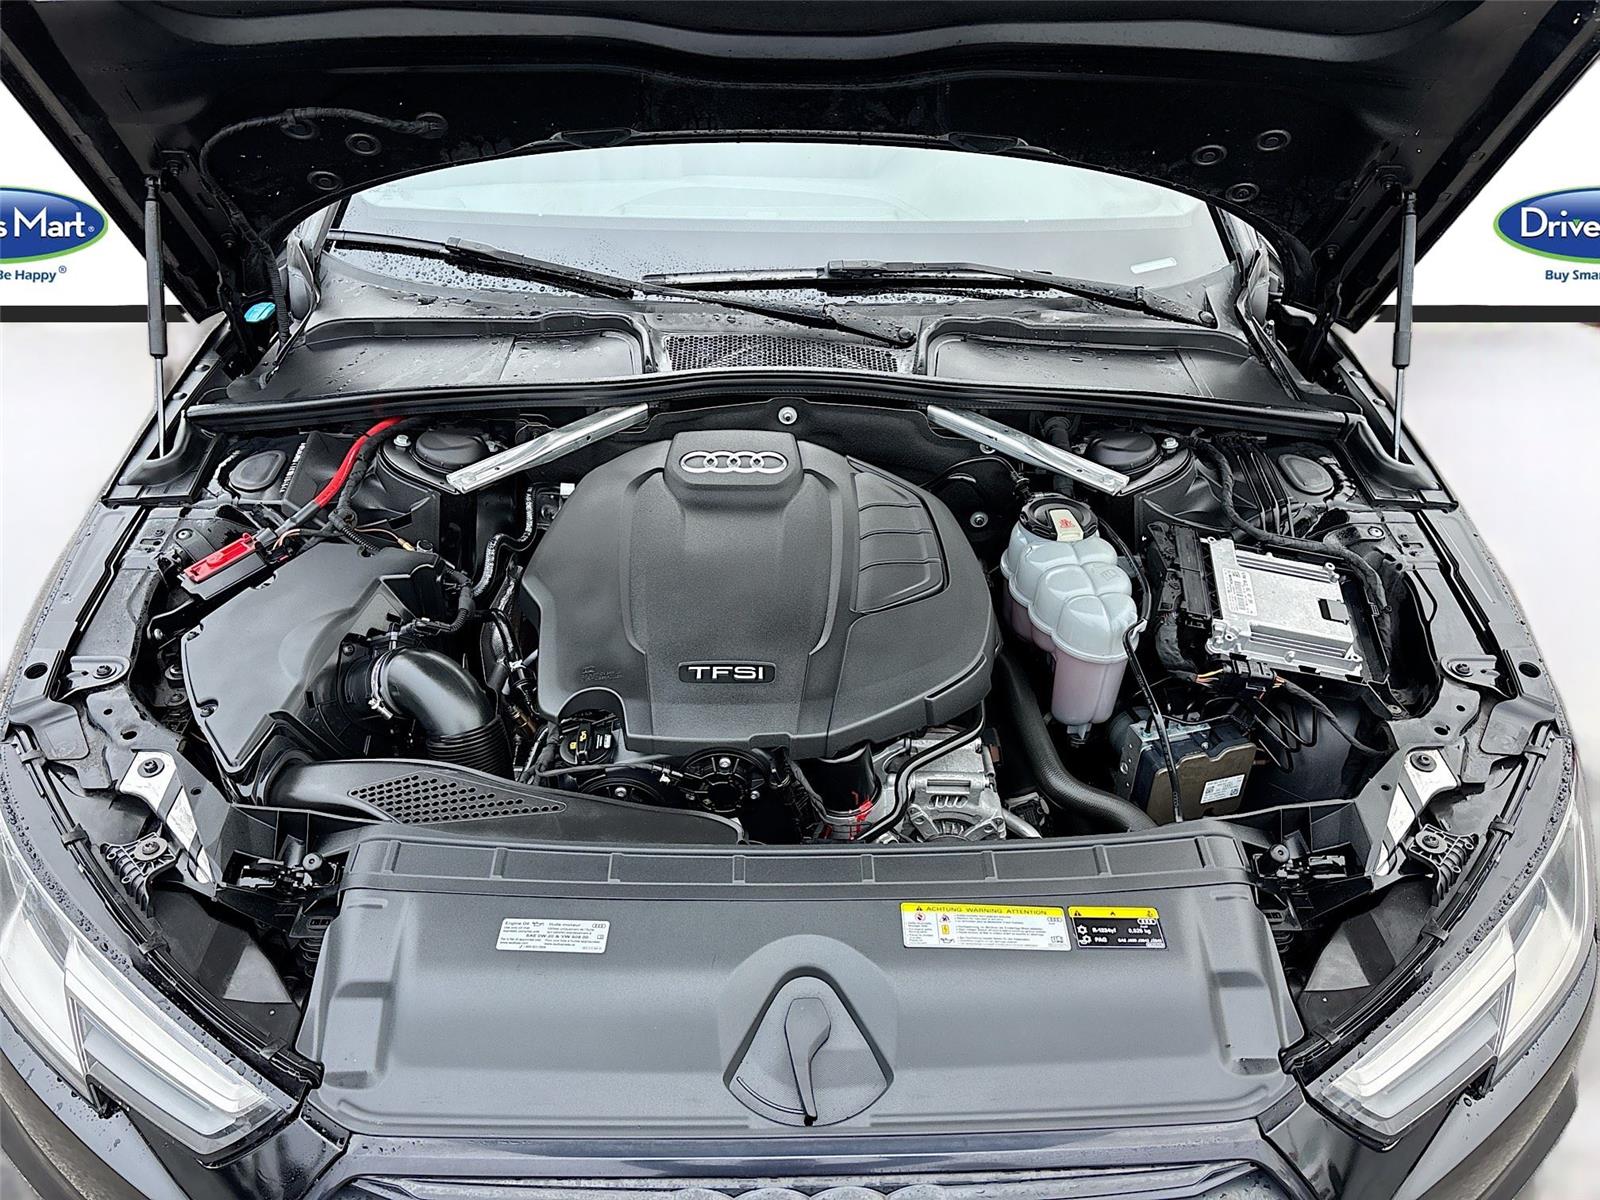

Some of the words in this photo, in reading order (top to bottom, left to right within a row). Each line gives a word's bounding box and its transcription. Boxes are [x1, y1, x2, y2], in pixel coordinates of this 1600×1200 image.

[14, 206, 86, 238] Mart
[1520, 206, 1600, 238] Drive
[1545, 269, 1570, 283] Buy
[687, 666, 764, 680] TFSI
